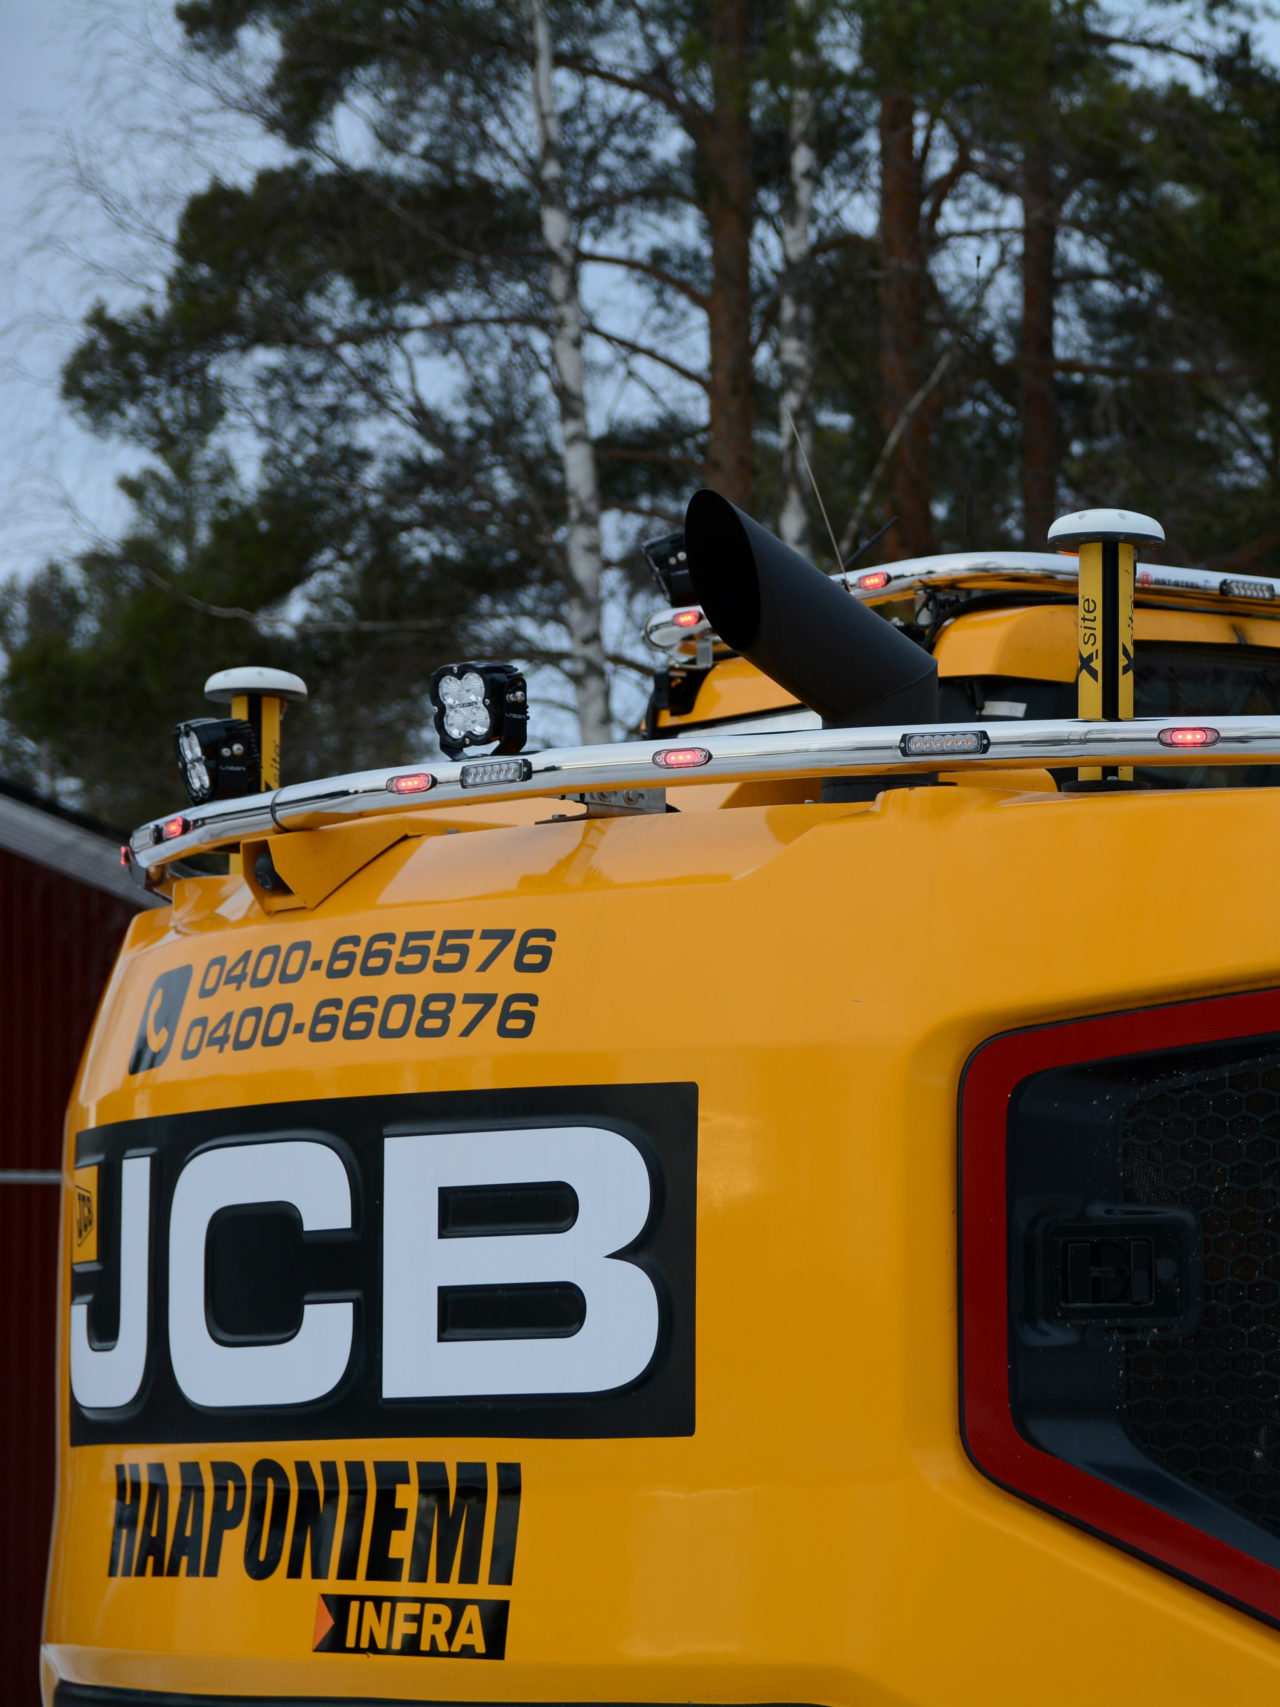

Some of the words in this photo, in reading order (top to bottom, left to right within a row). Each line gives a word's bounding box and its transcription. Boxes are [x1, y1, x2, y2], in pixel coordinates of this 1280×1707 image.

[198, 928, 557, 999] 0400-665576
[181, 992, 539, 1061] 0400-660876
[69, 1126, 660, 1409] JCB
[108, 1458, 522, 1585] HAAPONIEMI
[345, 1600, 487, 1654] INFRA
